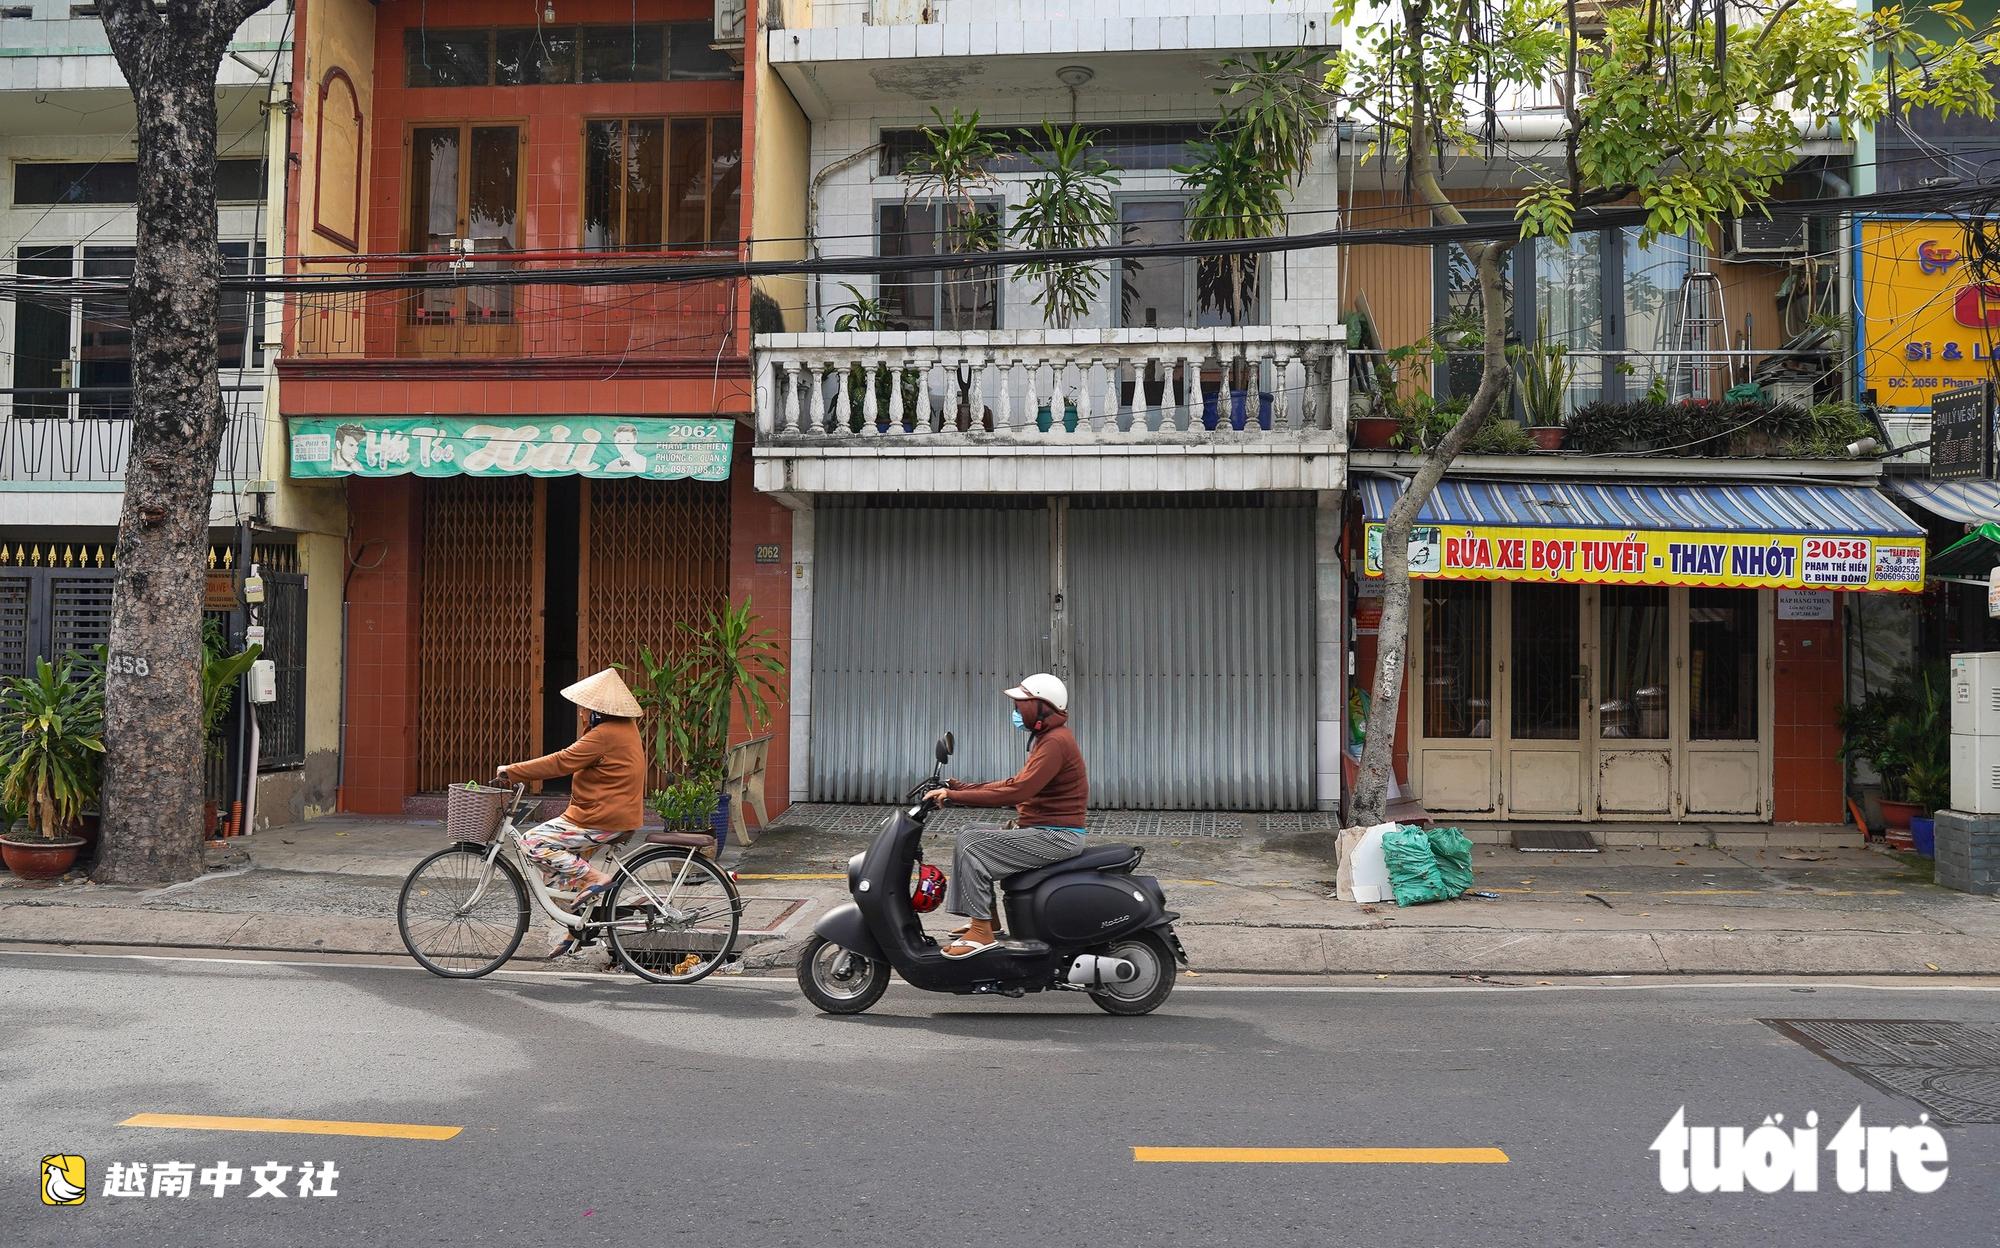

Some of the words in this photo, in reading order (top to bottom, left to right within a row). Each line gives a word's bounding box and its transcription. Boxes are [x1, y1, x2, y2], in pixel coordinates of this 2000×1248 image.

[1942, 342, 1963, 360] &
[1912, 377, 1938, 388] 2056
[668, 425, 718, 438] 2062
[757, 546, 779, 559] 2062
[1446, 530, 1493, 569] RỬA
[1496, 538, 1526, 570] XE
[1531, 540, 1576, 578] BỌT
[1581, 532, 1649, 573] TUYẾT
[1669, 543, 1728, 575] THAY
[1731, 540, 1797, 577] NHỚT
[1806, 540, 1867, 560] 2058
[1805, 561, 1829, 573] PHẠM
[1815, 573, 1838, 582] BÌNH
[1875, 572, 1920, 581] 0906096300
